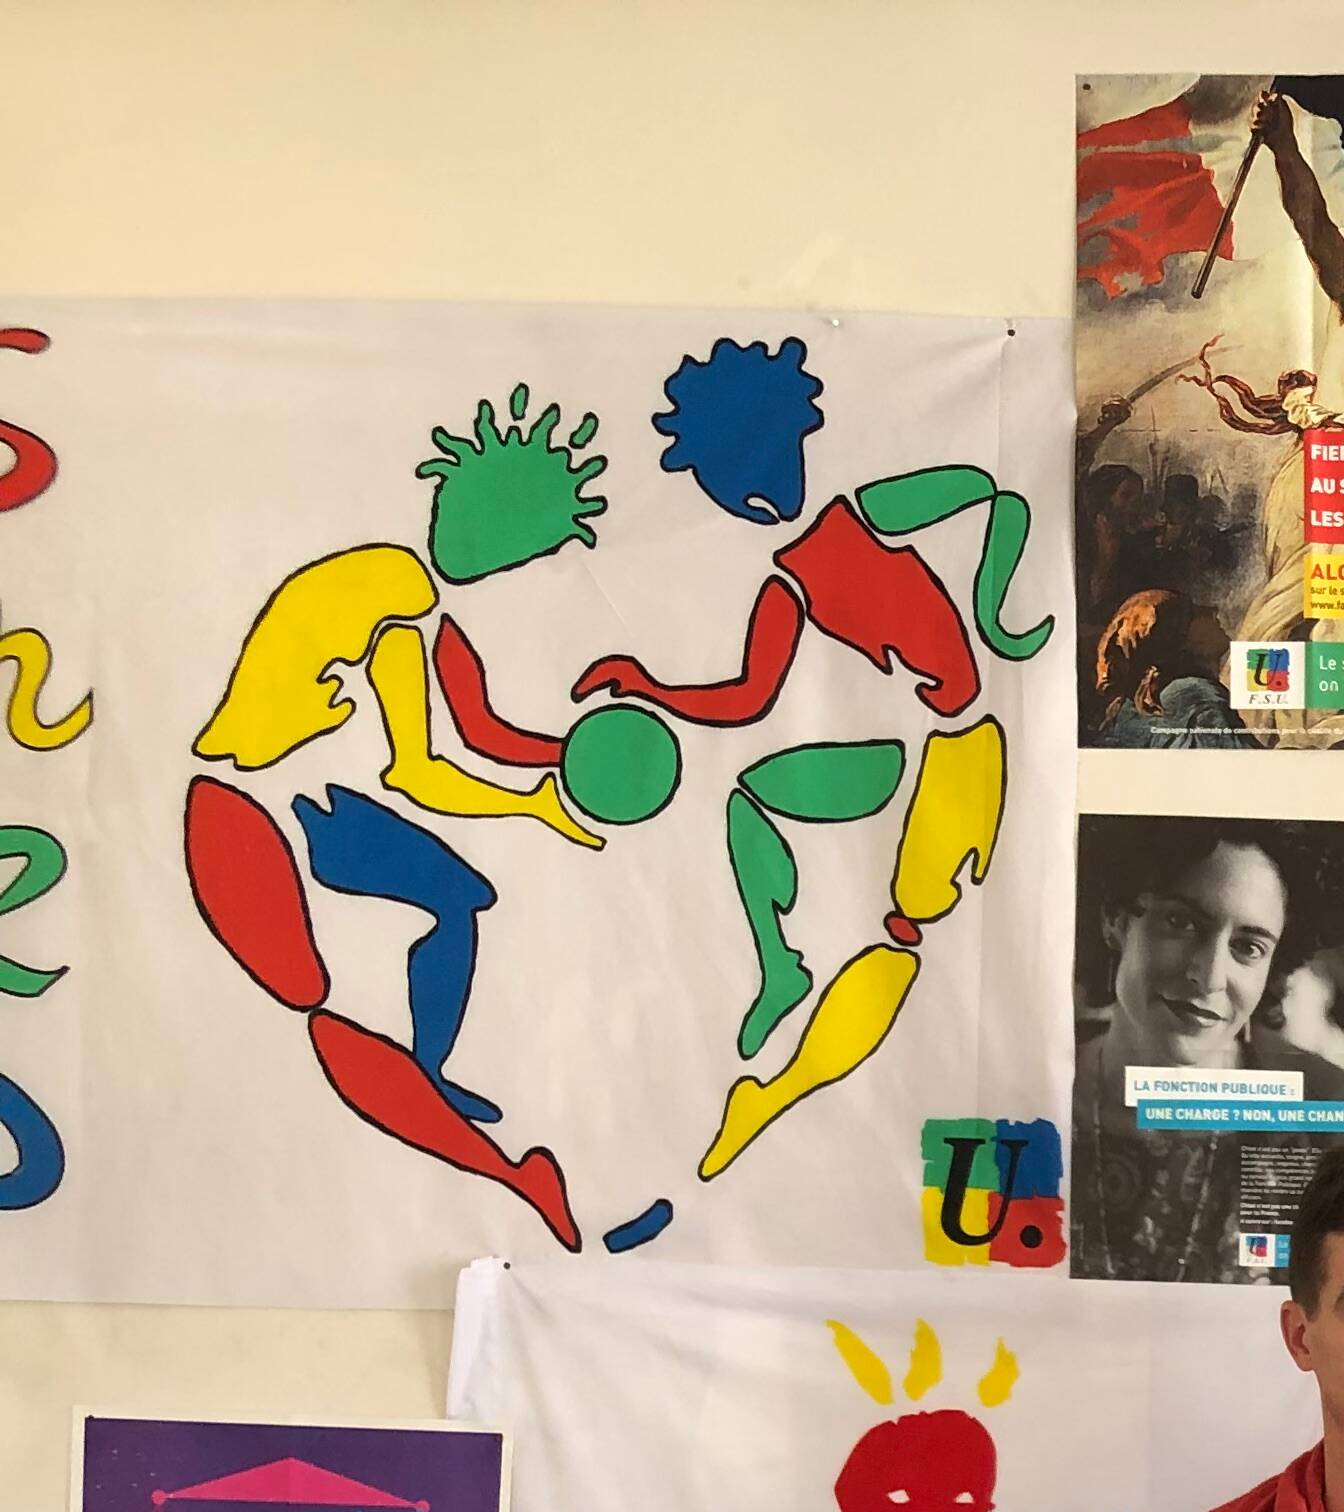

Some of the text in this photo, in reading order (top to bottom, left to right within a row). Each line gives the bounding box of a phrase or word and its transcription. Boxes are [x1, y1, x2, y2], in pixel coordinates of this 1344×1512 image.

[1310, 478, 1336, 494] AU
[1310, 511, 1344, 527] LES
[1329, 586, 1338, 595] le
[1319, 656, 1337, 670] Le
[1319, 681, 1339, 692] on
[1134, 1080, 1286, 1096] LA FONCTION PUBLIQUE
[1145, 1108, 1173, 1120] UNE
[1175, 1108, 1229, 1121] CHARGE
[1243, 1109, 1275, 1123] NON,
[1278, 1109, 1305, 1122] UNE
